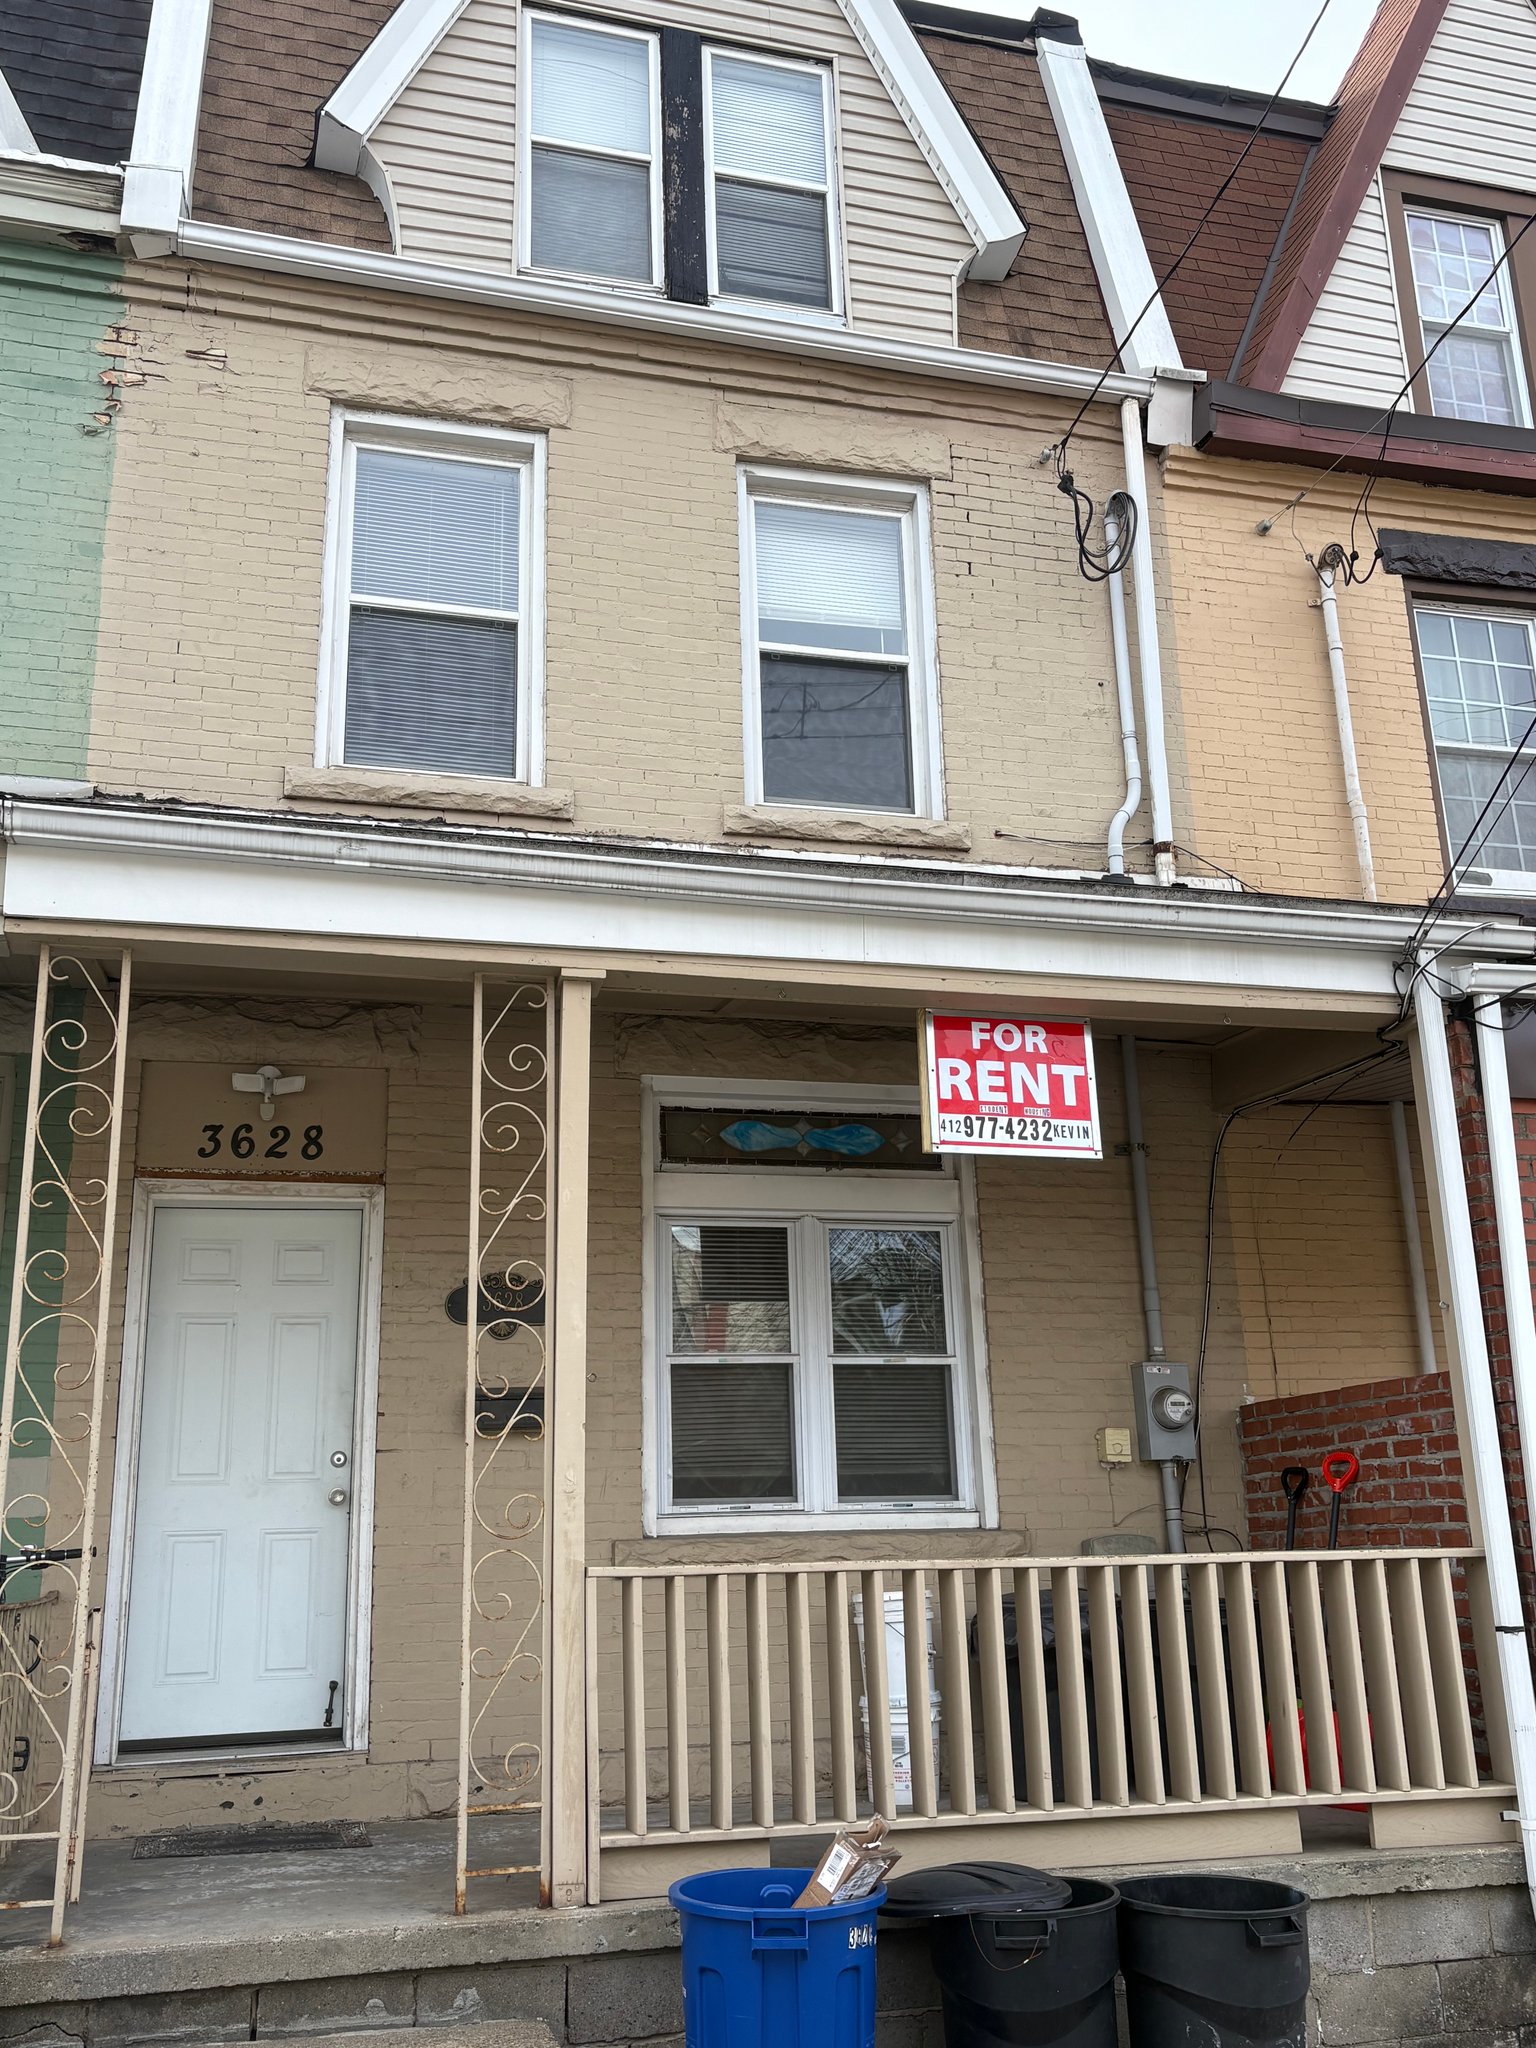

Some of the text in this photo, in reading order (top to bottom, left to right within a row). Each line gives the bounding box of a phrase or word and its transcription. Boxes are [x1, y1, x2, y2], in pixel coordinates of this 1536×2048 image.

[971, 1022, 1048, 1053] FOR
[938, 1057, 1085, 1107] RENT
[197, 1123, 324, 1161] 3628
[940, 1115, 1090, 1142] 412 977-4232 KEVIN
[482, 1291, 524, 1312] 3628
